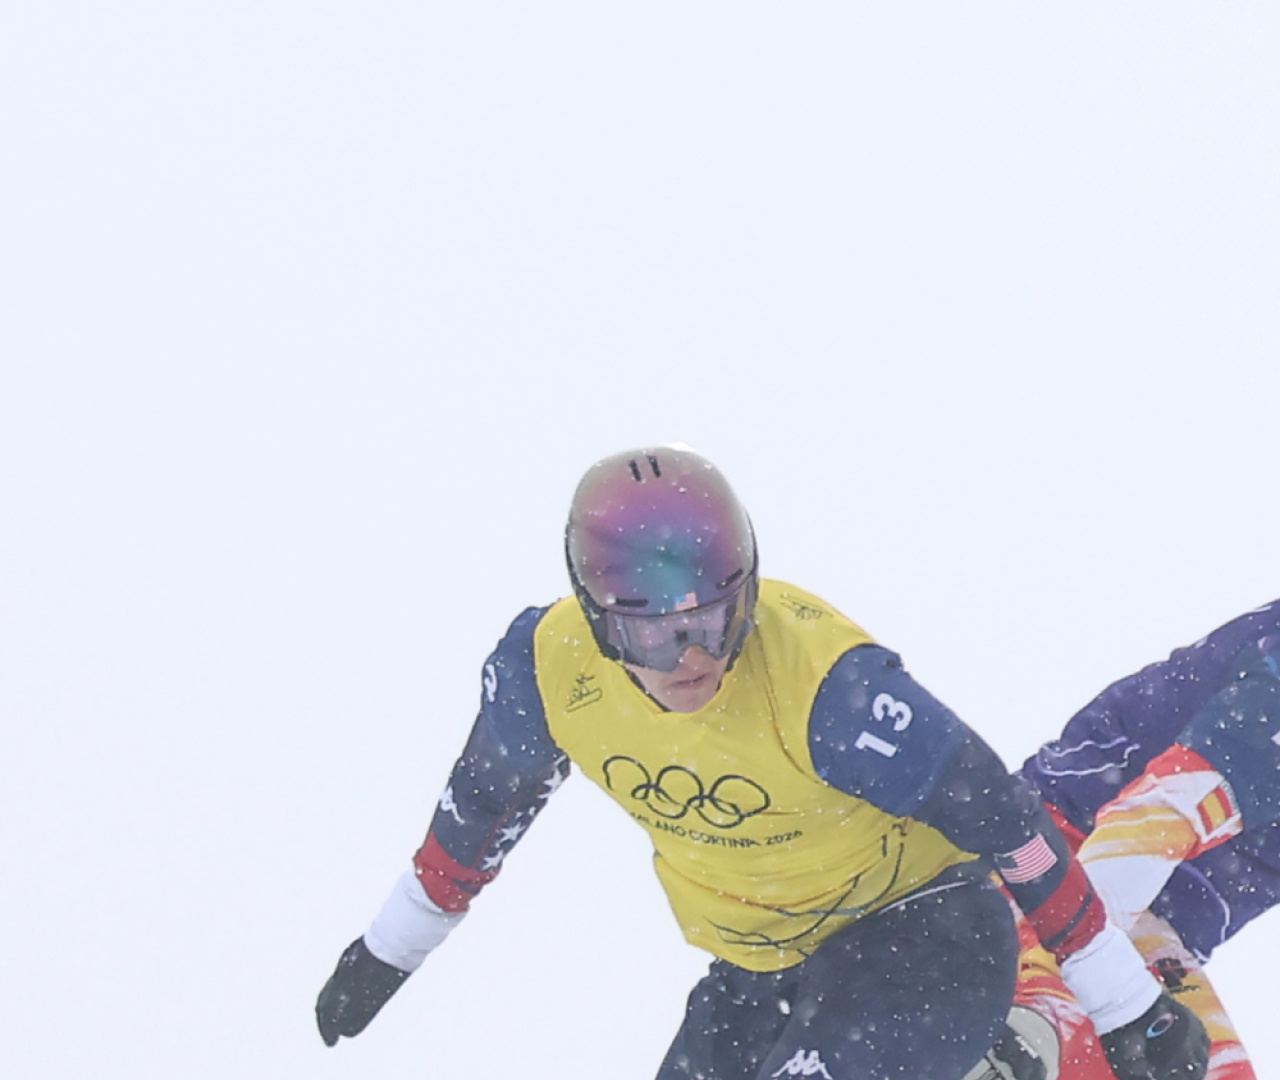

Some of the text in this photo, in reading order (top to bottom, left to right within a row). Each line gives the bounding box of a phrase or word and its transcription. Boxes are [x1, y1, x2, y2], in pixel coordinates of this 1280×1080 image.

[854, 692, 913, 758] 13
[689, 828, 762, 849] CORTINA
[765, 827, 803, 846] 2026
